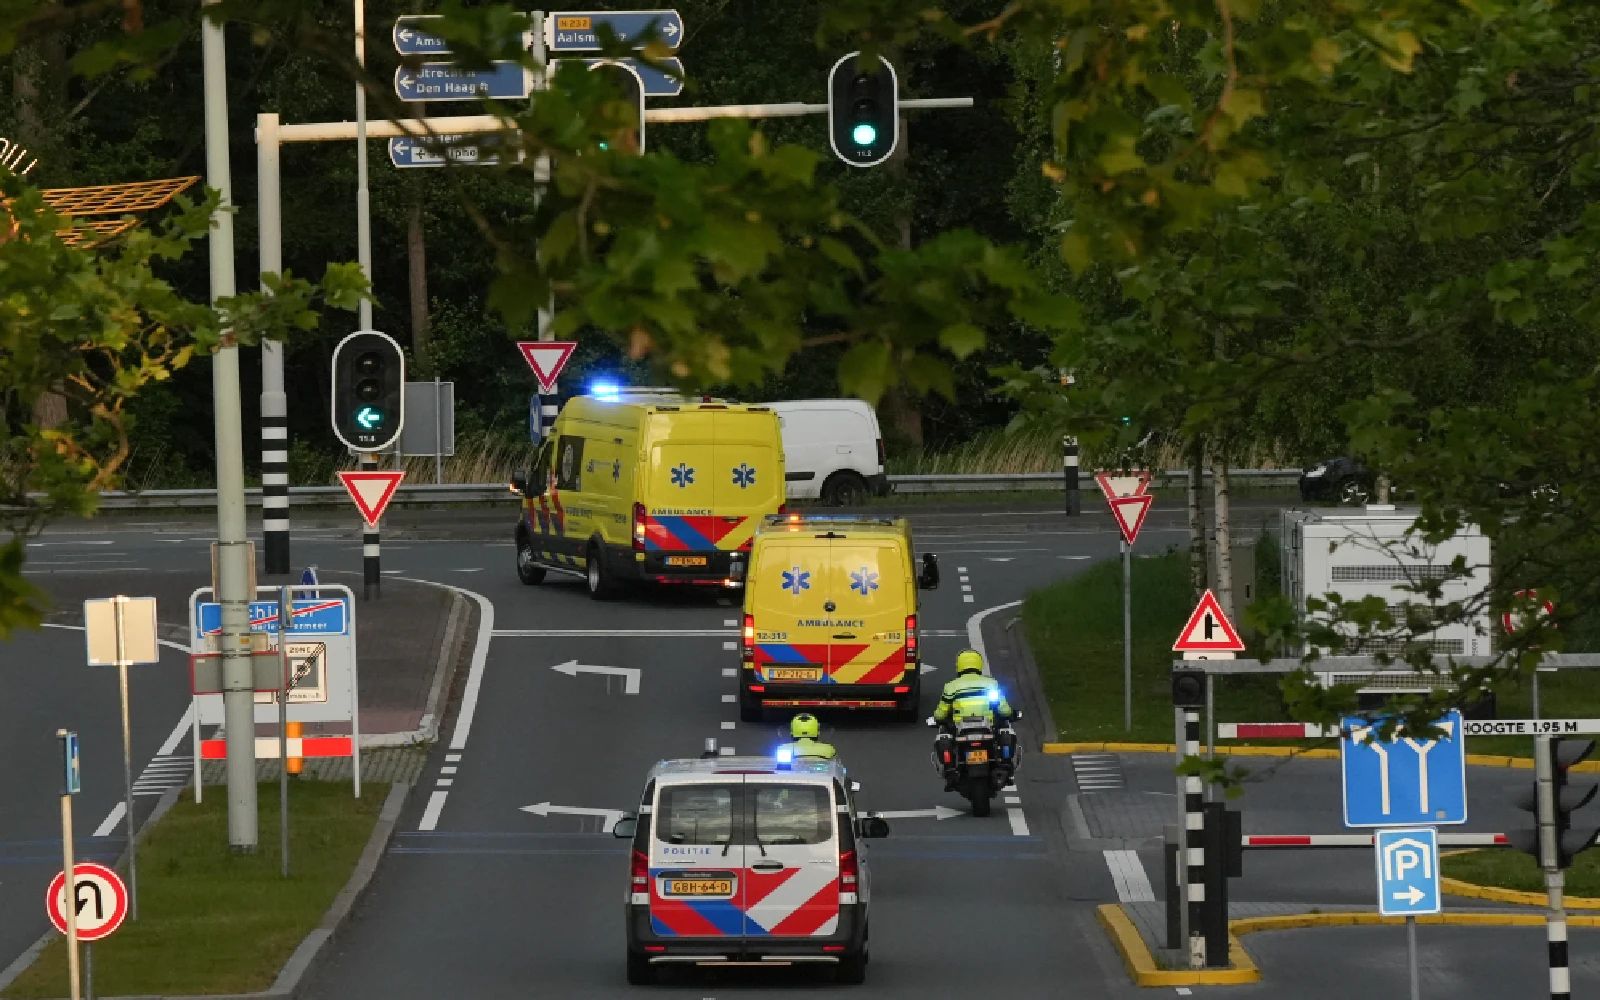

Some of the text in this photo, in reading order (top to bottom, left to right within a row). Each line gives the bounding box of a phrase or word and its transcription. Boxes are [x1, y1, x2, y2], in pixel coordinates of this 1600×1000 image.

[557, 32, 598, 43] Aalsm
[416, 83, 477, 94] Den Haag
[651, 507, 712, 515] AMBULANCE
[797, 619, 865, 627] AMBULANCE
[1463, 721, 1577, 733] HOOGTE 1.95 M
[663, 847, 712, 855] POLITIE
[1396, 850, 1420, 881] P
[673, 882, 728, 893] GBH-64-D
